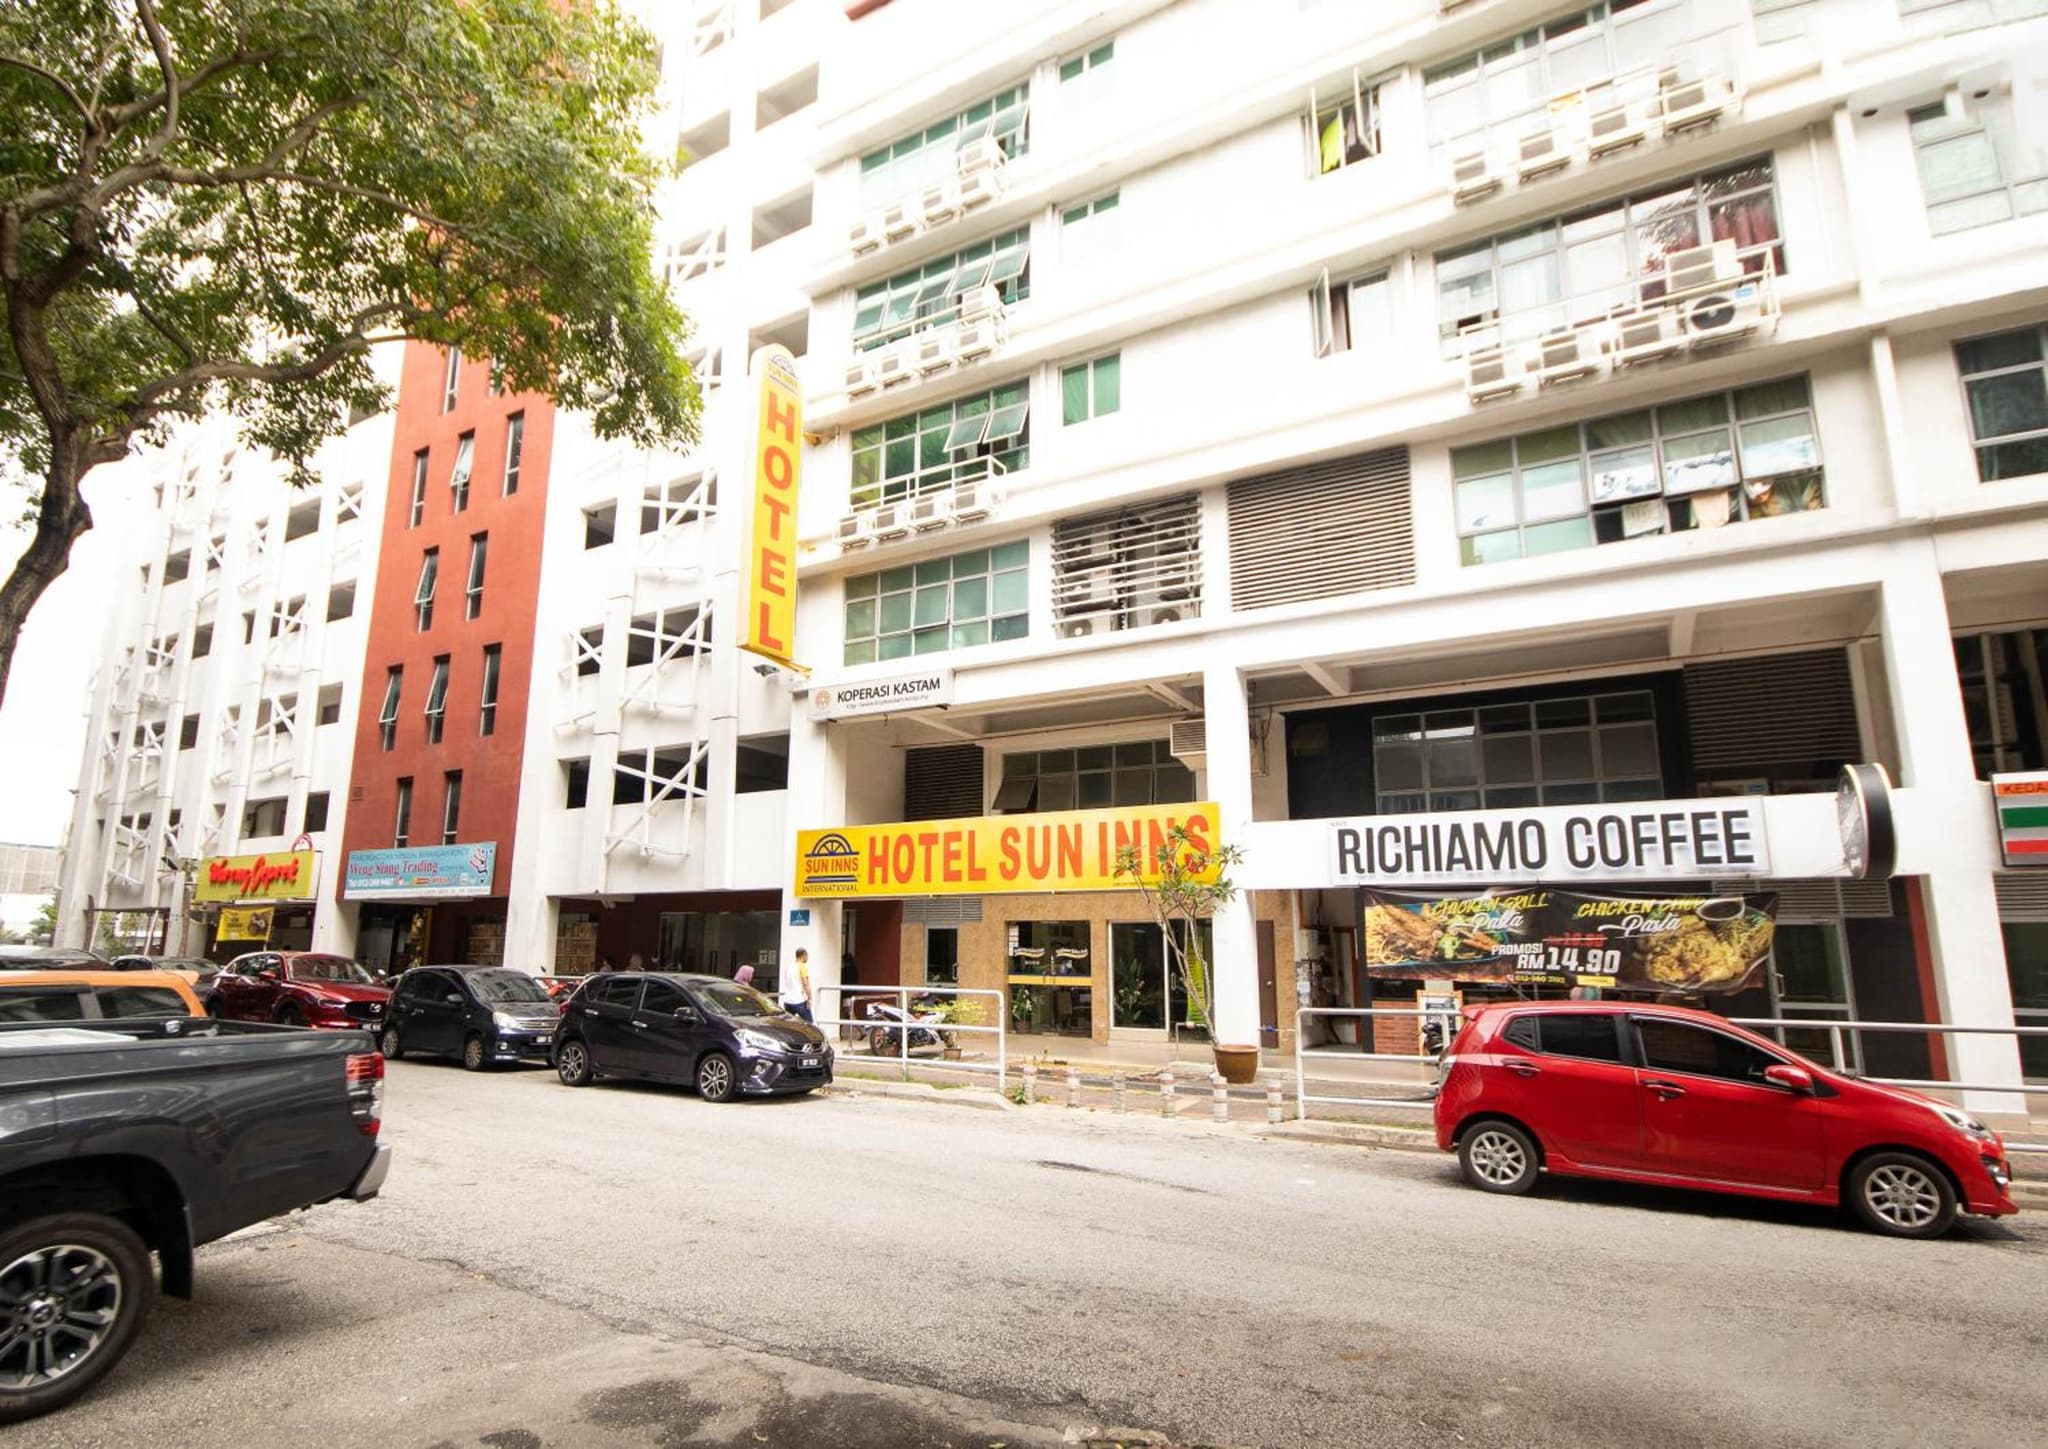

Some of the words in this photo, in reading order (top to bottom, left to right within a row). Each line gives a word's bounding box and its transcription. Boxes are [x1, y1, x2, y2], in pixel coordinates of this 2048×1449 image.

[759, 390, 795, 651] HOTEL
[837, 685, 890, 703] KOPERASI
[893, 677, 940, 695] KASTAM
[868, 830, 986, 885] HOTEL
[999, 823, 1083, 881] SUN
[1098, 814, 1210, 878] INNS
[1337, 818, 1548, 875] RICHIAMO
[1565, 809, 1755, 869] COFFEE
[402, 859, 438, 874] Trading
[805, 858, 829, 874] SUN
[830, 857, 859, 873] INNS
[802, 882, 858, 893] INTERNATIONAL
[1432, 897, 1501, 915] CHICKEN
[1503, 892, 1549, 910] GRILL
[1576, 899, 1653, 917] CHICKEN
[1454, 910, 1525, 934] Pasta
[1598, 913, 1681, 938] Pasta
[1491, 943, 1543, 955] PROMOSI
[1516, 953, 1545, 969] RM
[1546, 946, 1621, 973] 14.90
